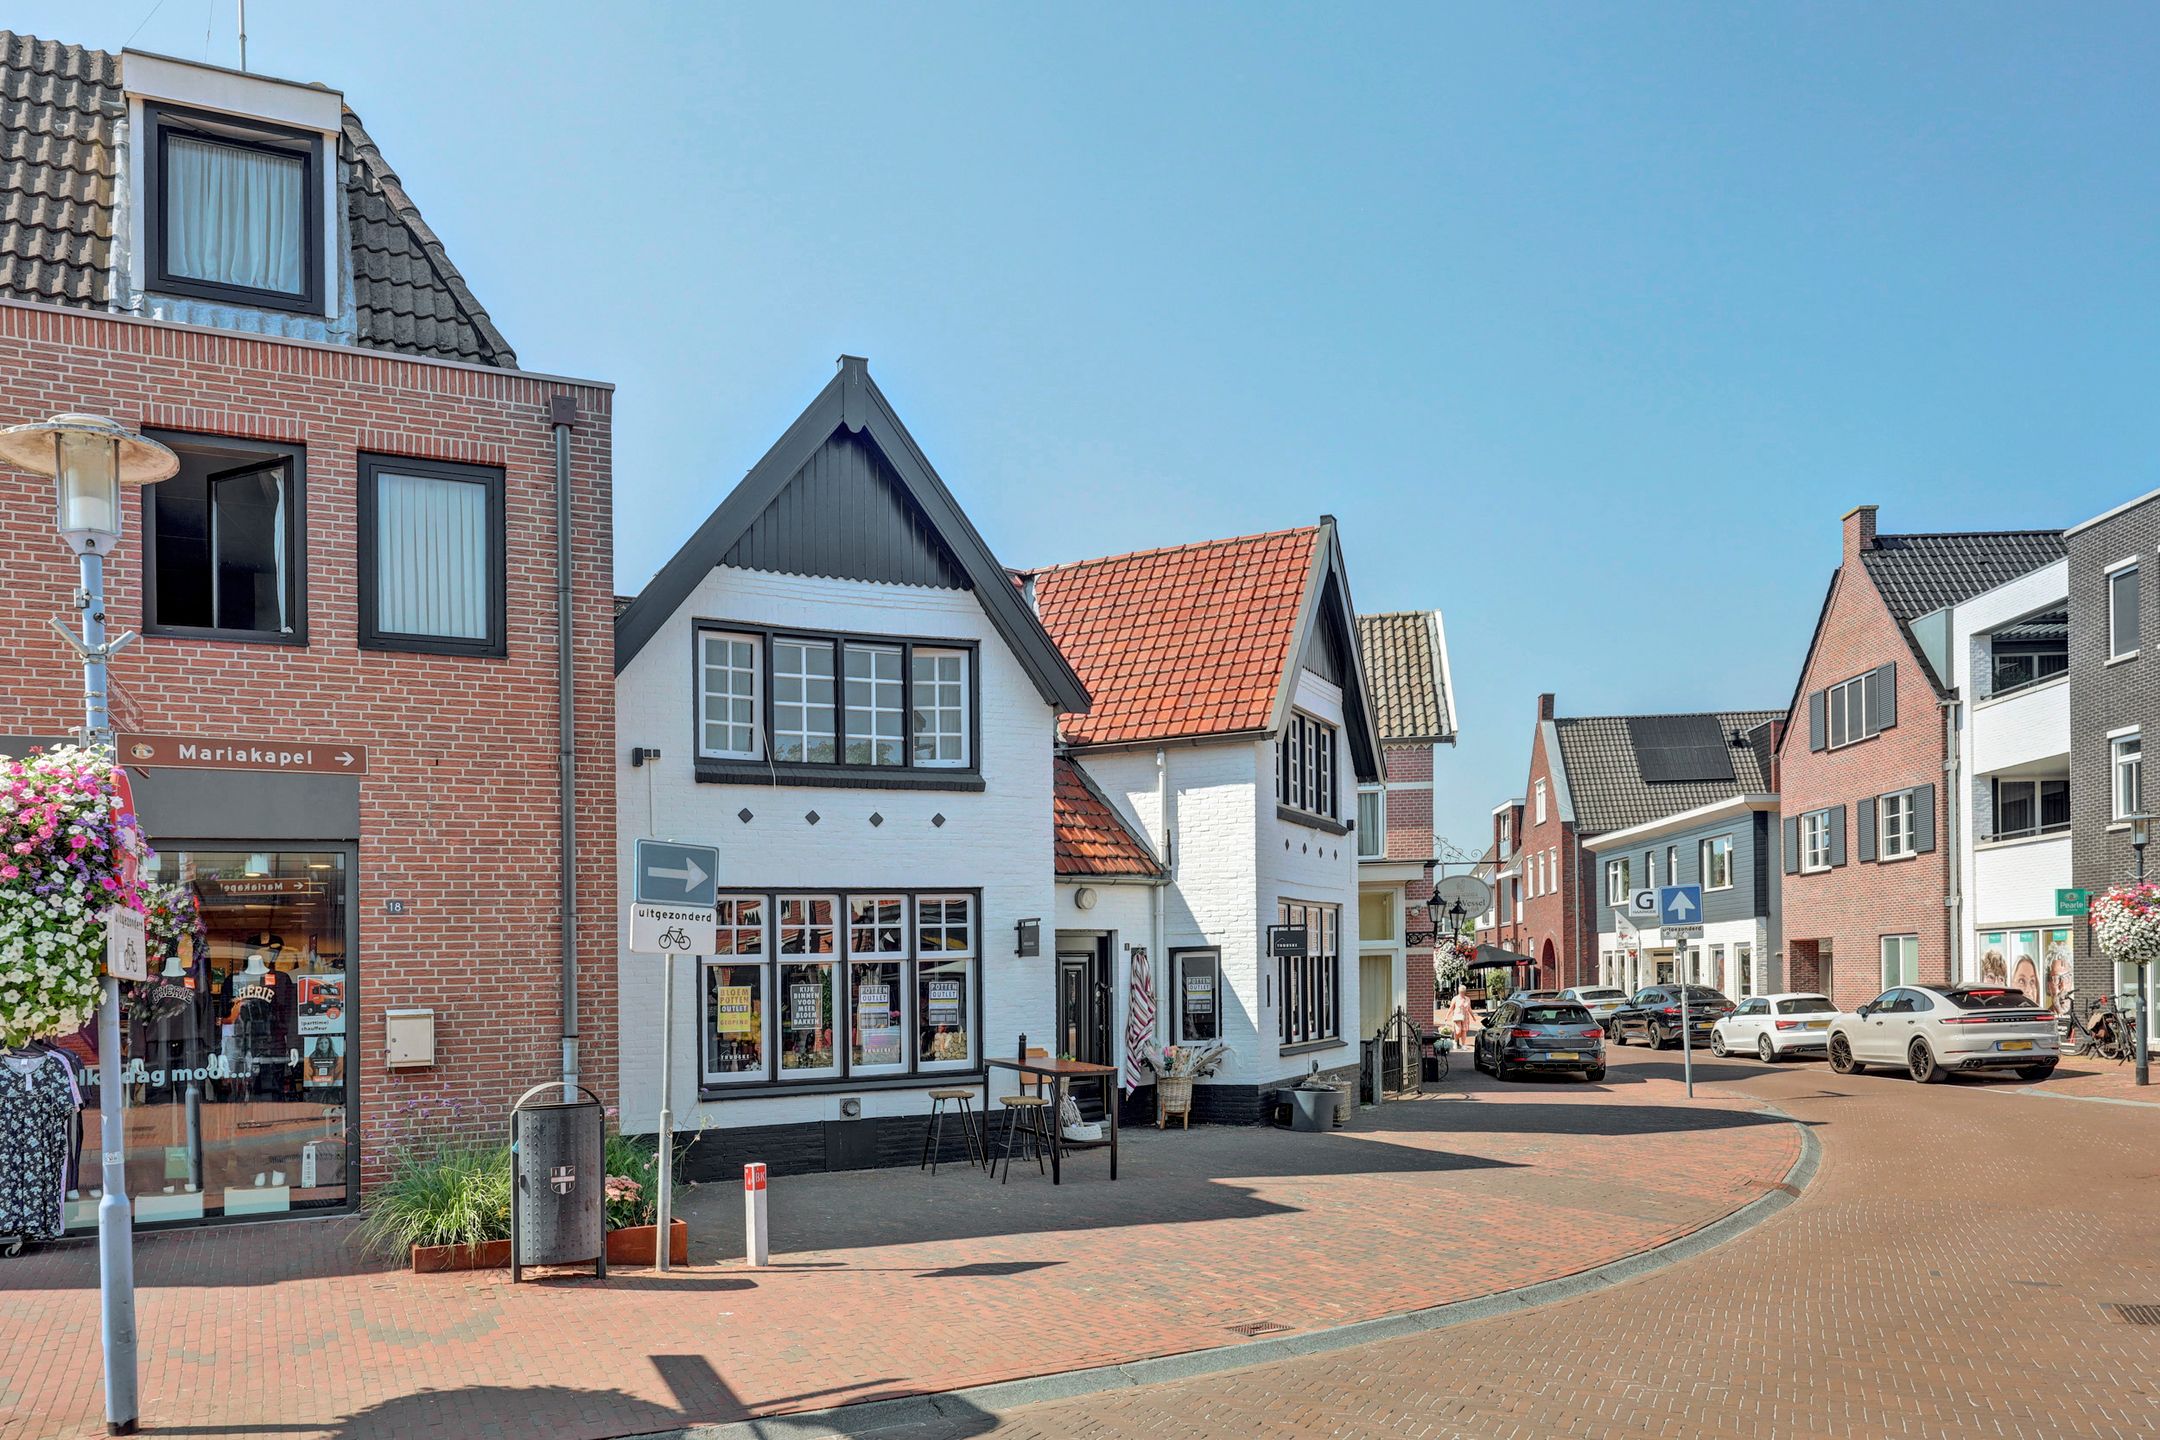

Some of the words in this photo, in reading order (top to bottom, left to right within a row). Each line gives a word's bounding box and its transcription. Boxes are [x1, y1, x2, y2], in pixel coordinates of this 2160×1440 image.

[179, 744, 312, 766] Mariakapel
[390, 902, 402, 912] 18
[1635, 891, 1654, 909] G
[639, 908, 712, 922] uitgezonderd
[121, 1067, 166, 1087] dag
[755, 1172, 766, 1182] BK
